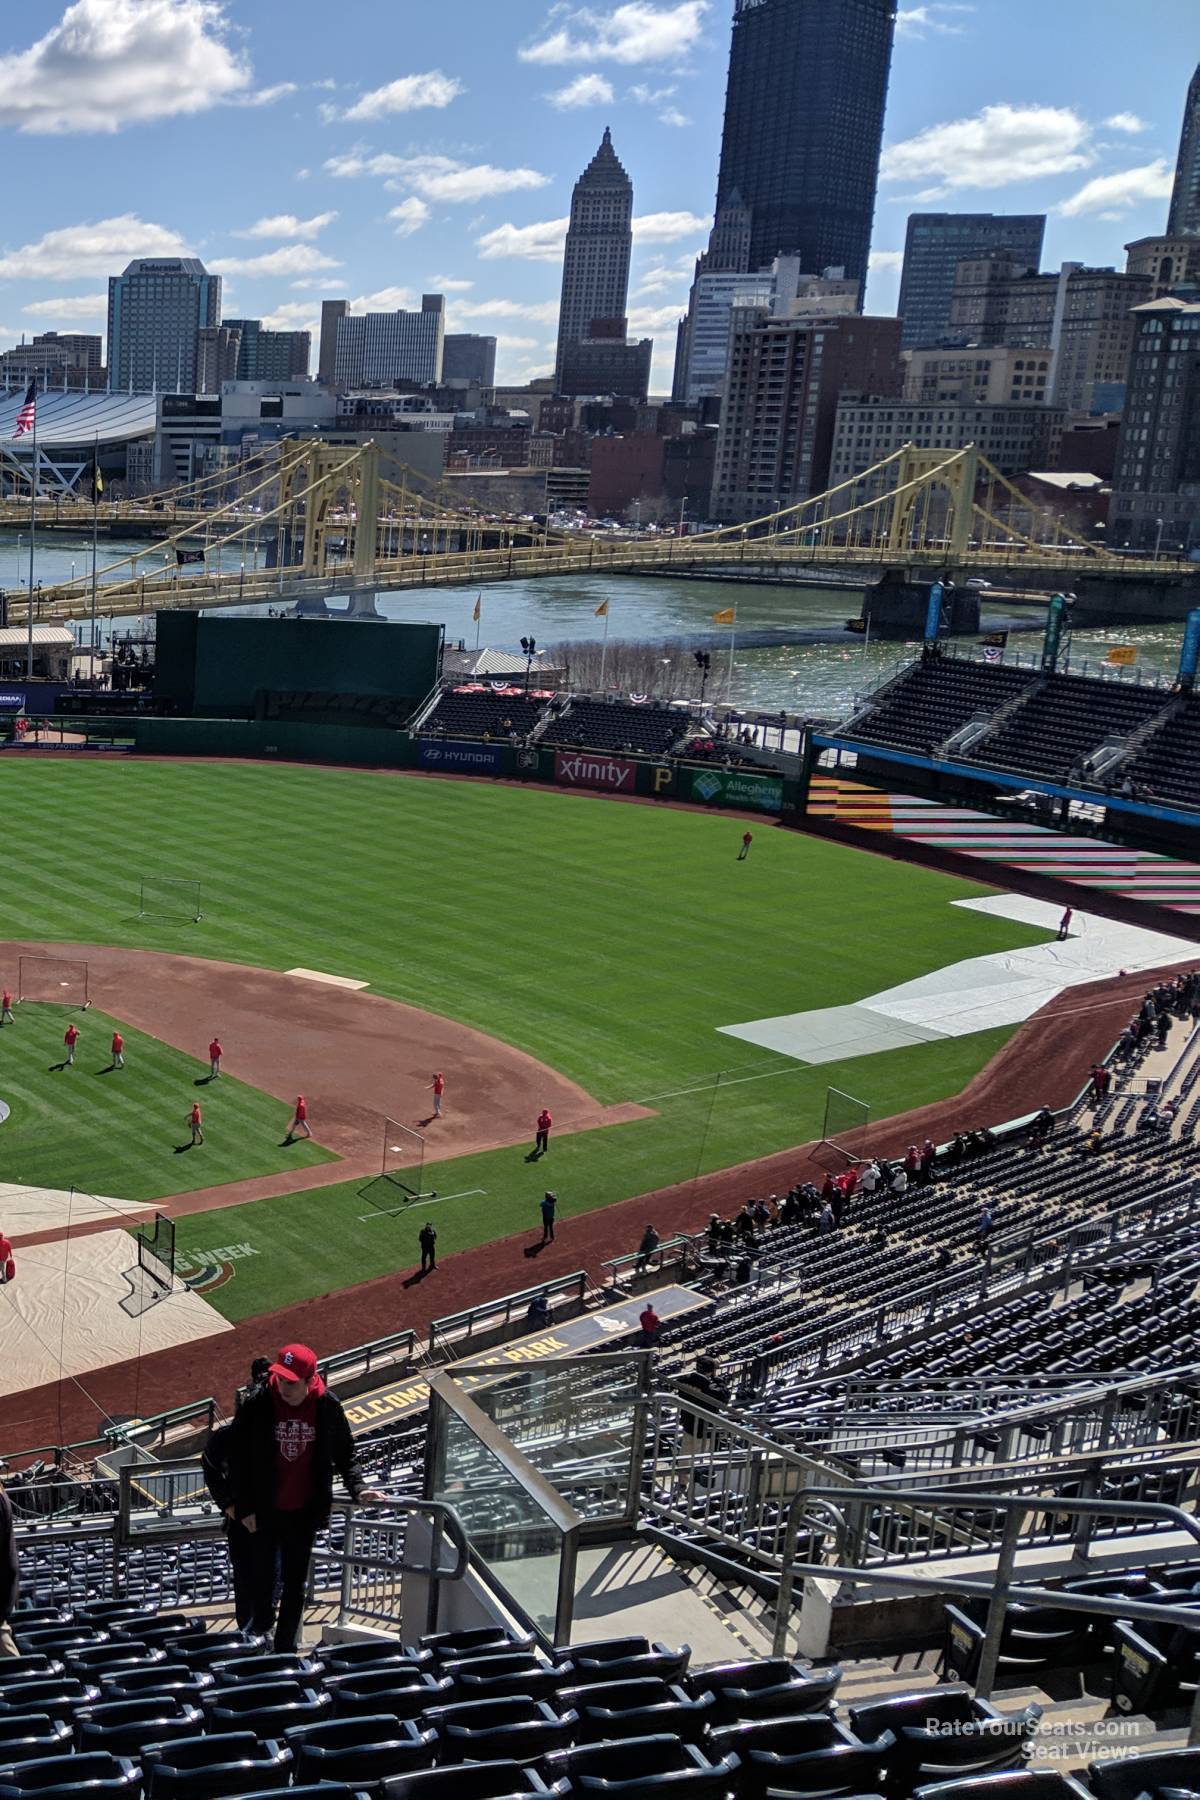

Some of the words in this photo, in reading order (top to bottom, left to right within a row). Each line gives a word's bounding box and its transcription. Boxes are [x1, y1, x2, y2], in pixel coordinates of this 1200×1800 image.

[444, 751, 495, 764] HYUNDAI
[559, 756, 630, 787] xfinity
[654, 767, 673, 792] P
[726, 779, 783, 797] Allegheny
[189, 1242, 261, 1267] WEEK
[504, 1335, 569, 1364] PARK
[344, 1382, 431, 1425] ELCOME
